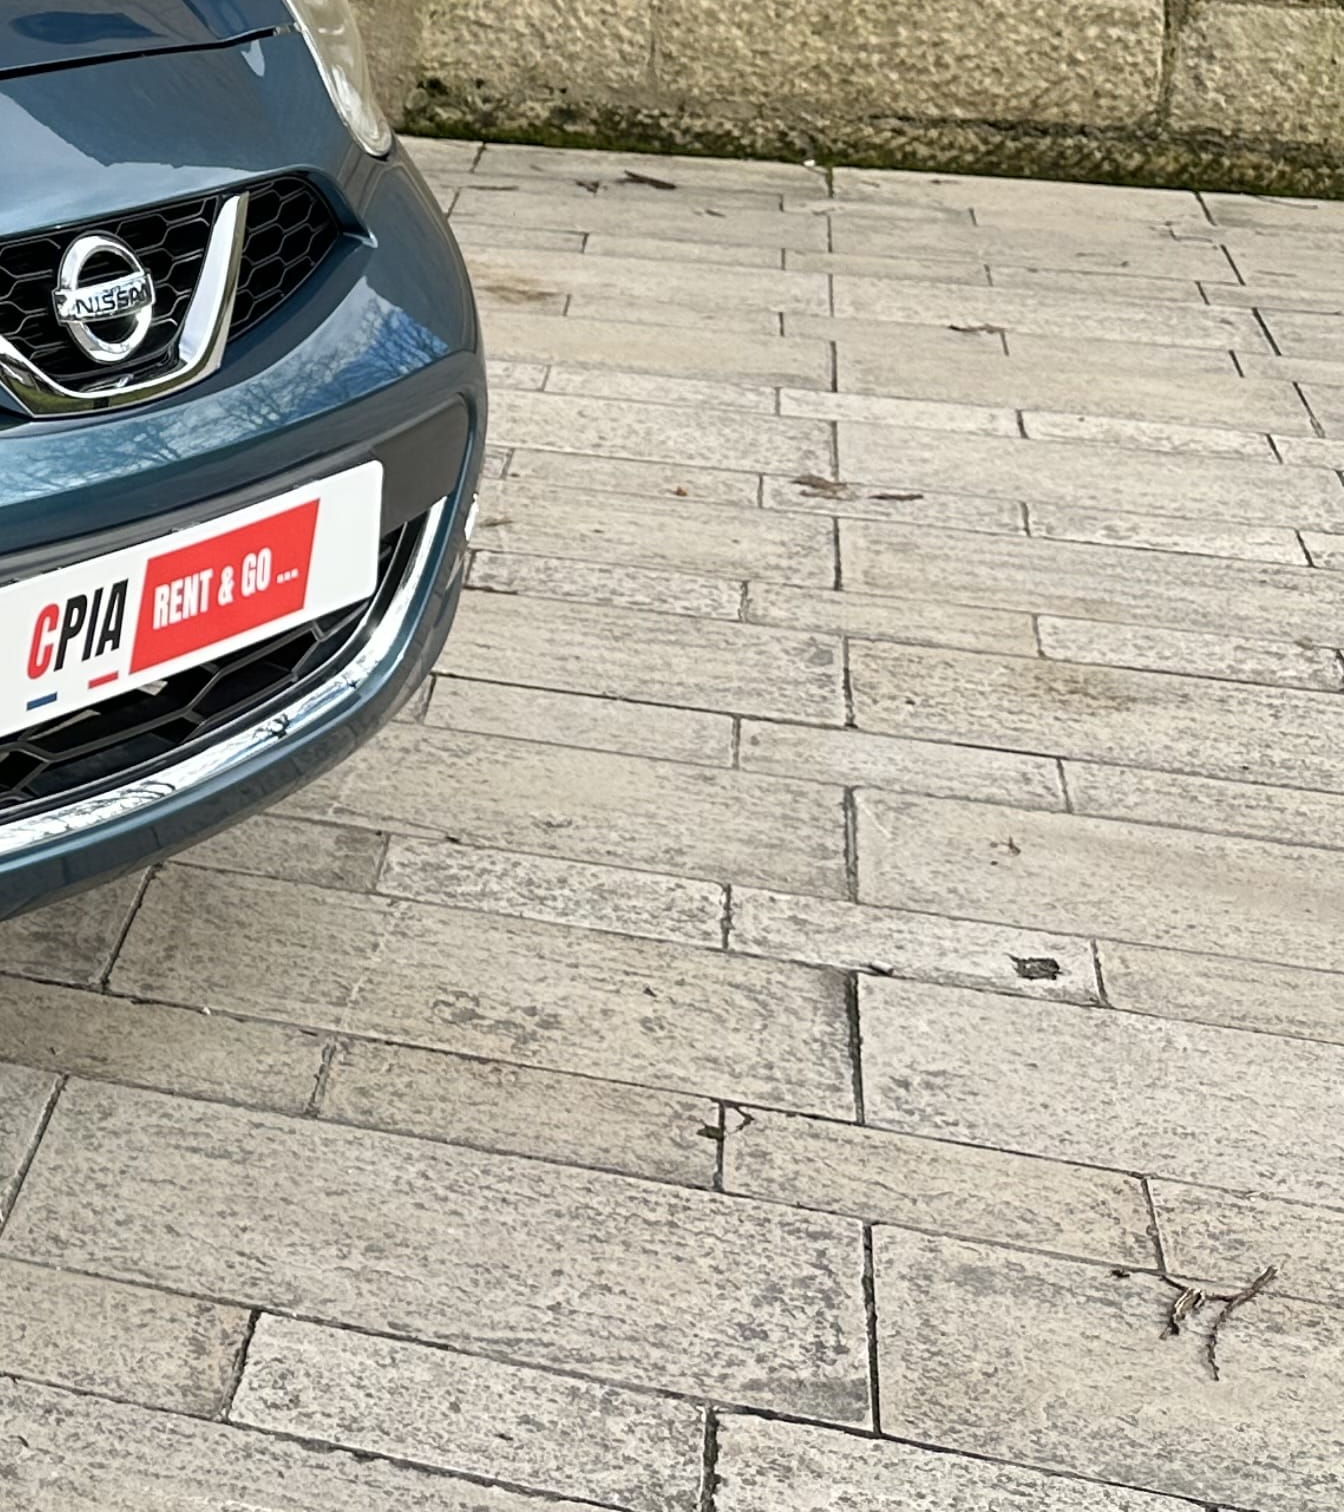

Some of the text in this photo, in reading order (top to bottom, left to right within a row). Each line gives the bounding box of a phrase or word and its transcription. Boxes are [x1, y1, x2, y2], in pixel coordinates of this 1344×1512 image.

[27, 577, 128, 679] CPIA
[153, 568, 213, 630] RENT
[218, 565, 234, 606] &
[241, 547, 272, 597] GO
